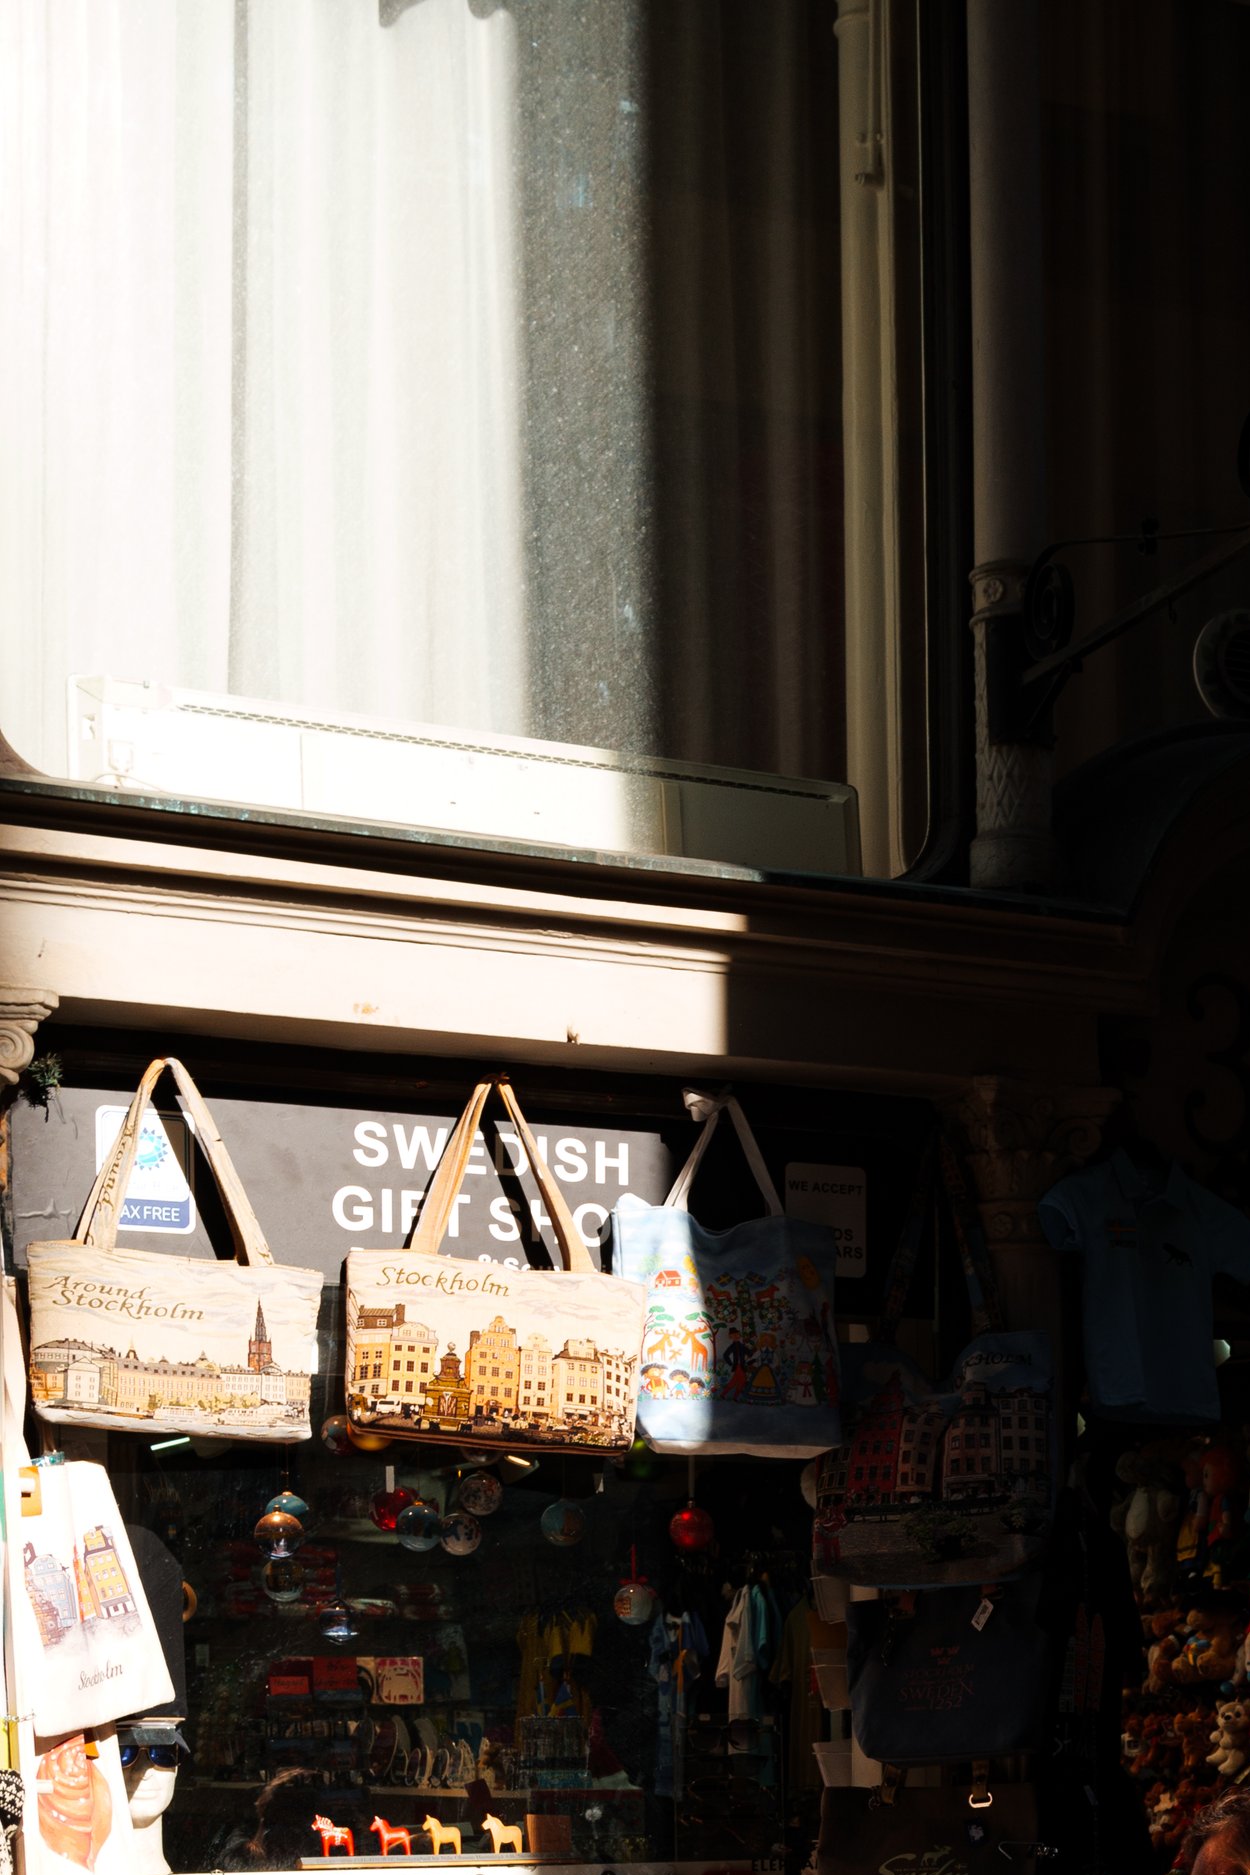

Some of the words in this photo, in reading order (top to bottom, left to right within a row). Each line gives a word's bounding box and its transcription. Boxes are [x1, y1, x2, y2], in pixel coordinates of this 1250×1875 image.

[789, 1180, 809, 1192] WE
[813, 1182, 864, 1195] ACCEPT
[120, 1204, 141, 1220] AX
[143, 1206, 181, 1222] FREE
[488, 1196, 611, 1248] SHO
[42, 1275, 152, 1300] Around
[376, 1265, 511, 1298] Stockholm
[52, 1288, 205, 1321] Stockholm
